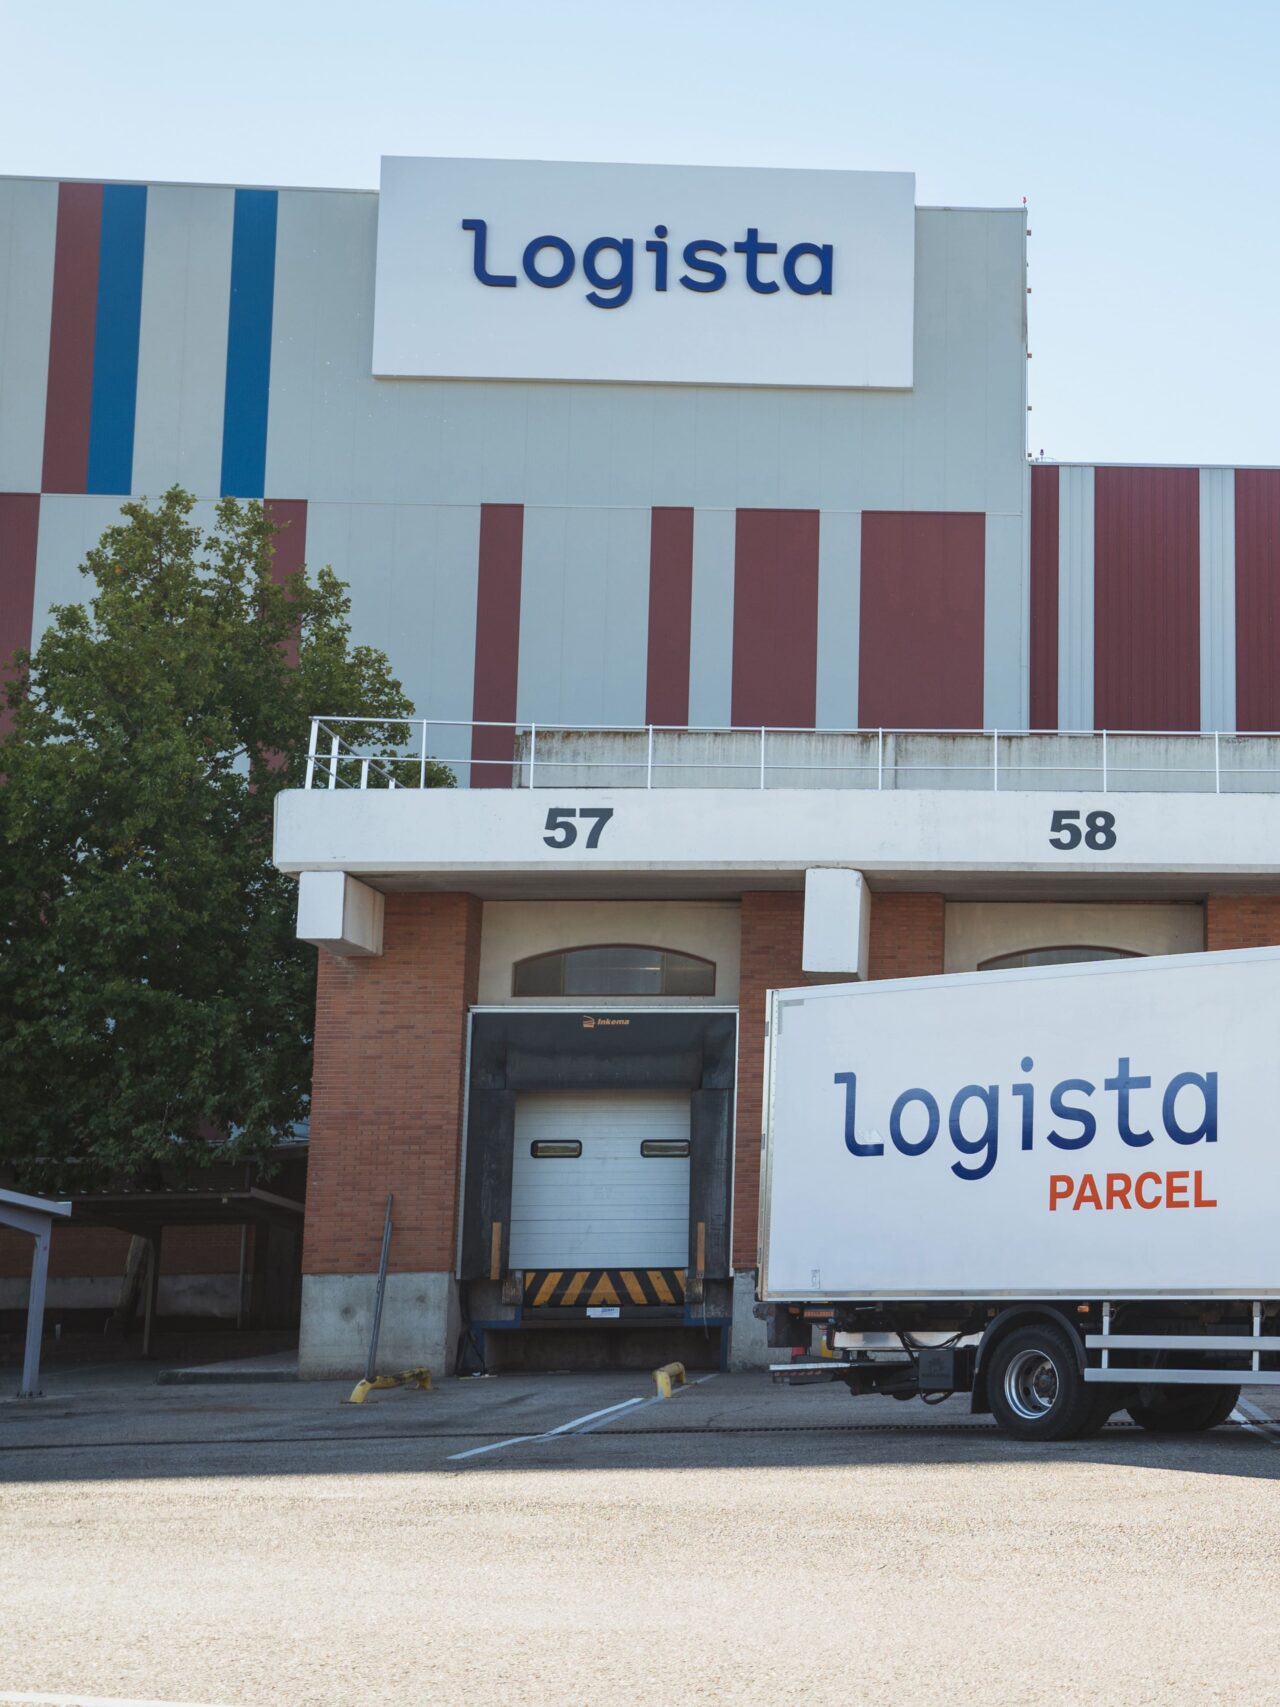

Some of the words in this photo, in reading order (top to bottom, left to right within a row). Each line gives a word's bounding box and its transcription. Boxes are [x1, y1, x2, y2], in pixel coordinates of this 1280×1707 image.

[461, 218, 834, 310] logista
[544, 808, 614, 850] 57
[1049, 810, 1117, 852] 58
[833, 1056, 1218, 1181] logista
[1049, 1170, 1217, 1212] PARCEL
